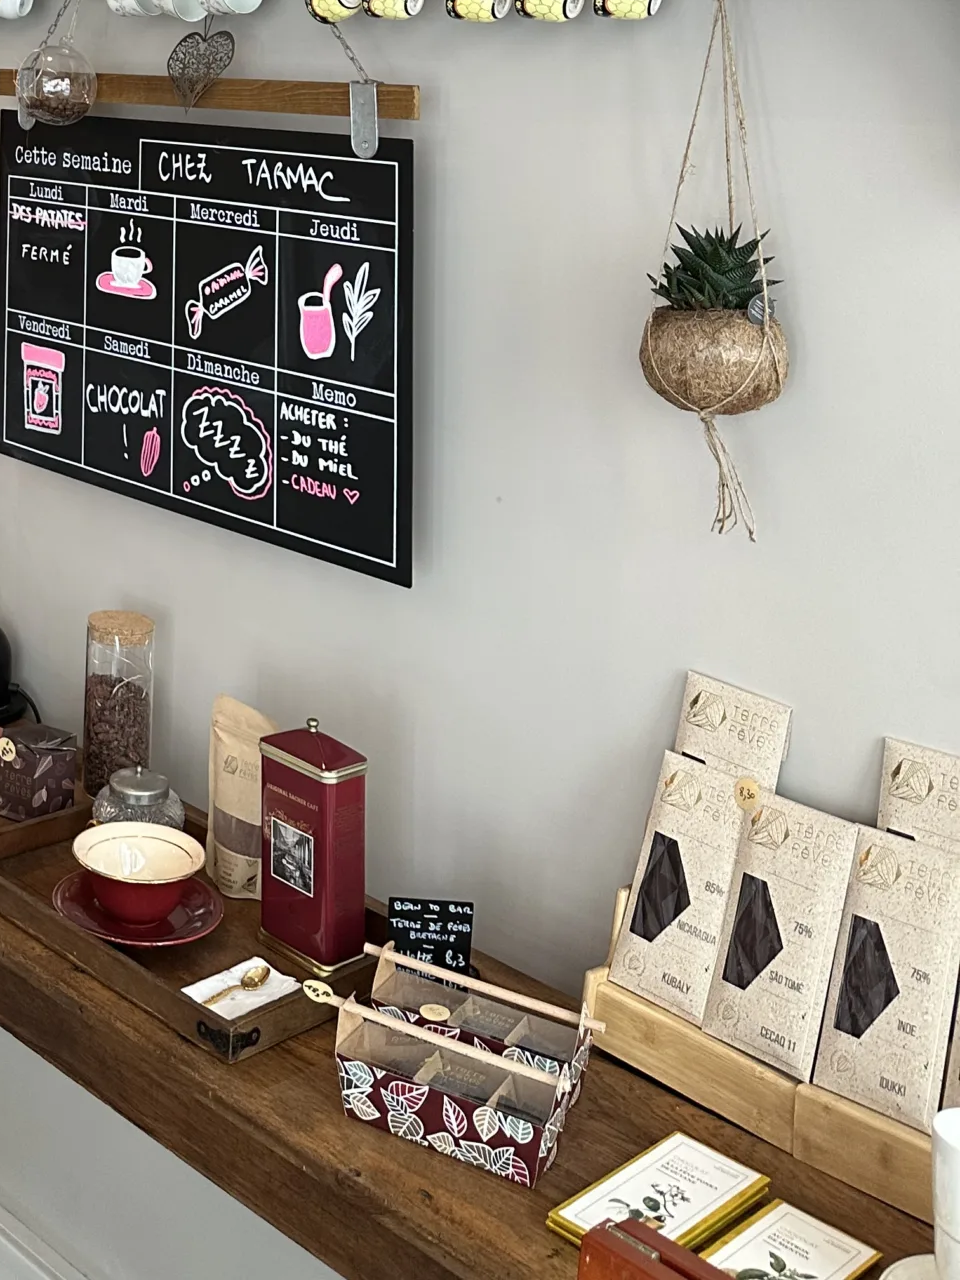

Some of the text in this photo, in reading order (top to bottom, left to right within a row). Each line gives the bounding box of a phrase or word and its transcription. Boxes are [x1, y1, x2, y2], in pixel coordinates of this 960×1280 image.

[15, 145, 132, 175] Cette semaine
[158, 151, 351, 202] CHEZ TARMAC
[29, 182, 64, 201] Lundi
[109, 192, 149, 212] Mardi
[189, 202, 261, 228] Mercredi
[309, 218, 361, 242] Jeudi
[21, 243, 73, 265] FERMÉ
[209, 285, 248, 315] CARAMEL
[18, 314, 72, 340] Vendredi
[104, 335, 151, 359] Samedi
[187, 353, 261, 385] Dimanche
[85, 383, 167, 419] CHOCOLAT
[311, 381, 357, 408] Memo
[280, 401, 337, 430] ACHETER
[290, 430, 312, 448] DU
[317, 434, 349, 457] THÉ
[291, 450, 309, 468] DU
[290, 472, 337, 499] CADEAU
[739, 786, 756, 801] 8,30
[704, 879, 726, 898] 85%
[429, 903, 440, 912] TO
[448, 904, 473, 915] BAR
[409, 930, 457, 942] BRETAGNE
[428, 921, 443, 931] DE
[676, 918, 717, 946] NICARAGUA
[793, 920, 814, 939] 75%
[661, 971, 692, 996] KUBALY
[911, 966, 932, 986] 75%
[897, 1019, 918, 1038] INDE
[879, 1075, 907, 1097] IDUKKI
